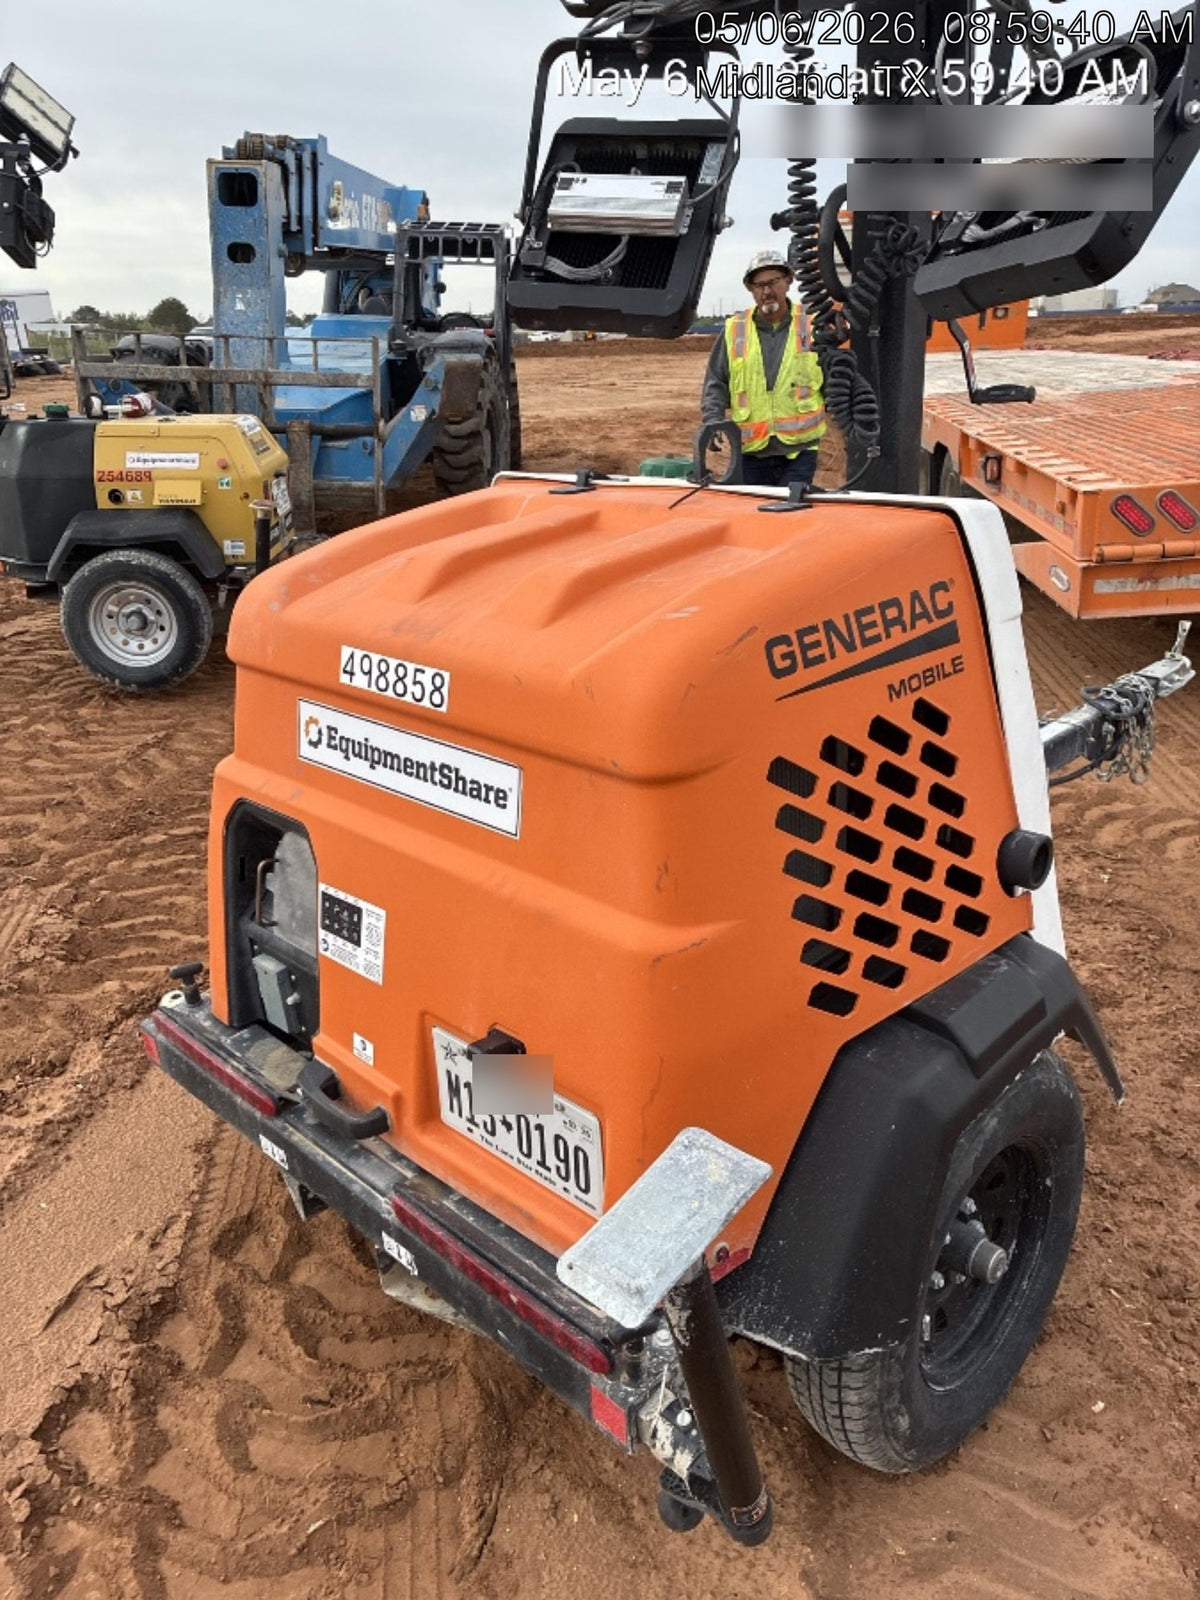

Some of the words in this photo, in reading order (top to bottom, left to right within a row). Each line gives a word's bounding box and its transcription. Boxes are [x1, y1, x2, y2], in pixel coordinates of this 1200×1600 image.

[97, 470, 152, 483] 254689
[764, 580, 955, 680] GENERAC
[342, 650, 446, 708] 498858
[887, 654, 966, 702] MOBILE
[326, 725, 509, 810] EquipmentShare
